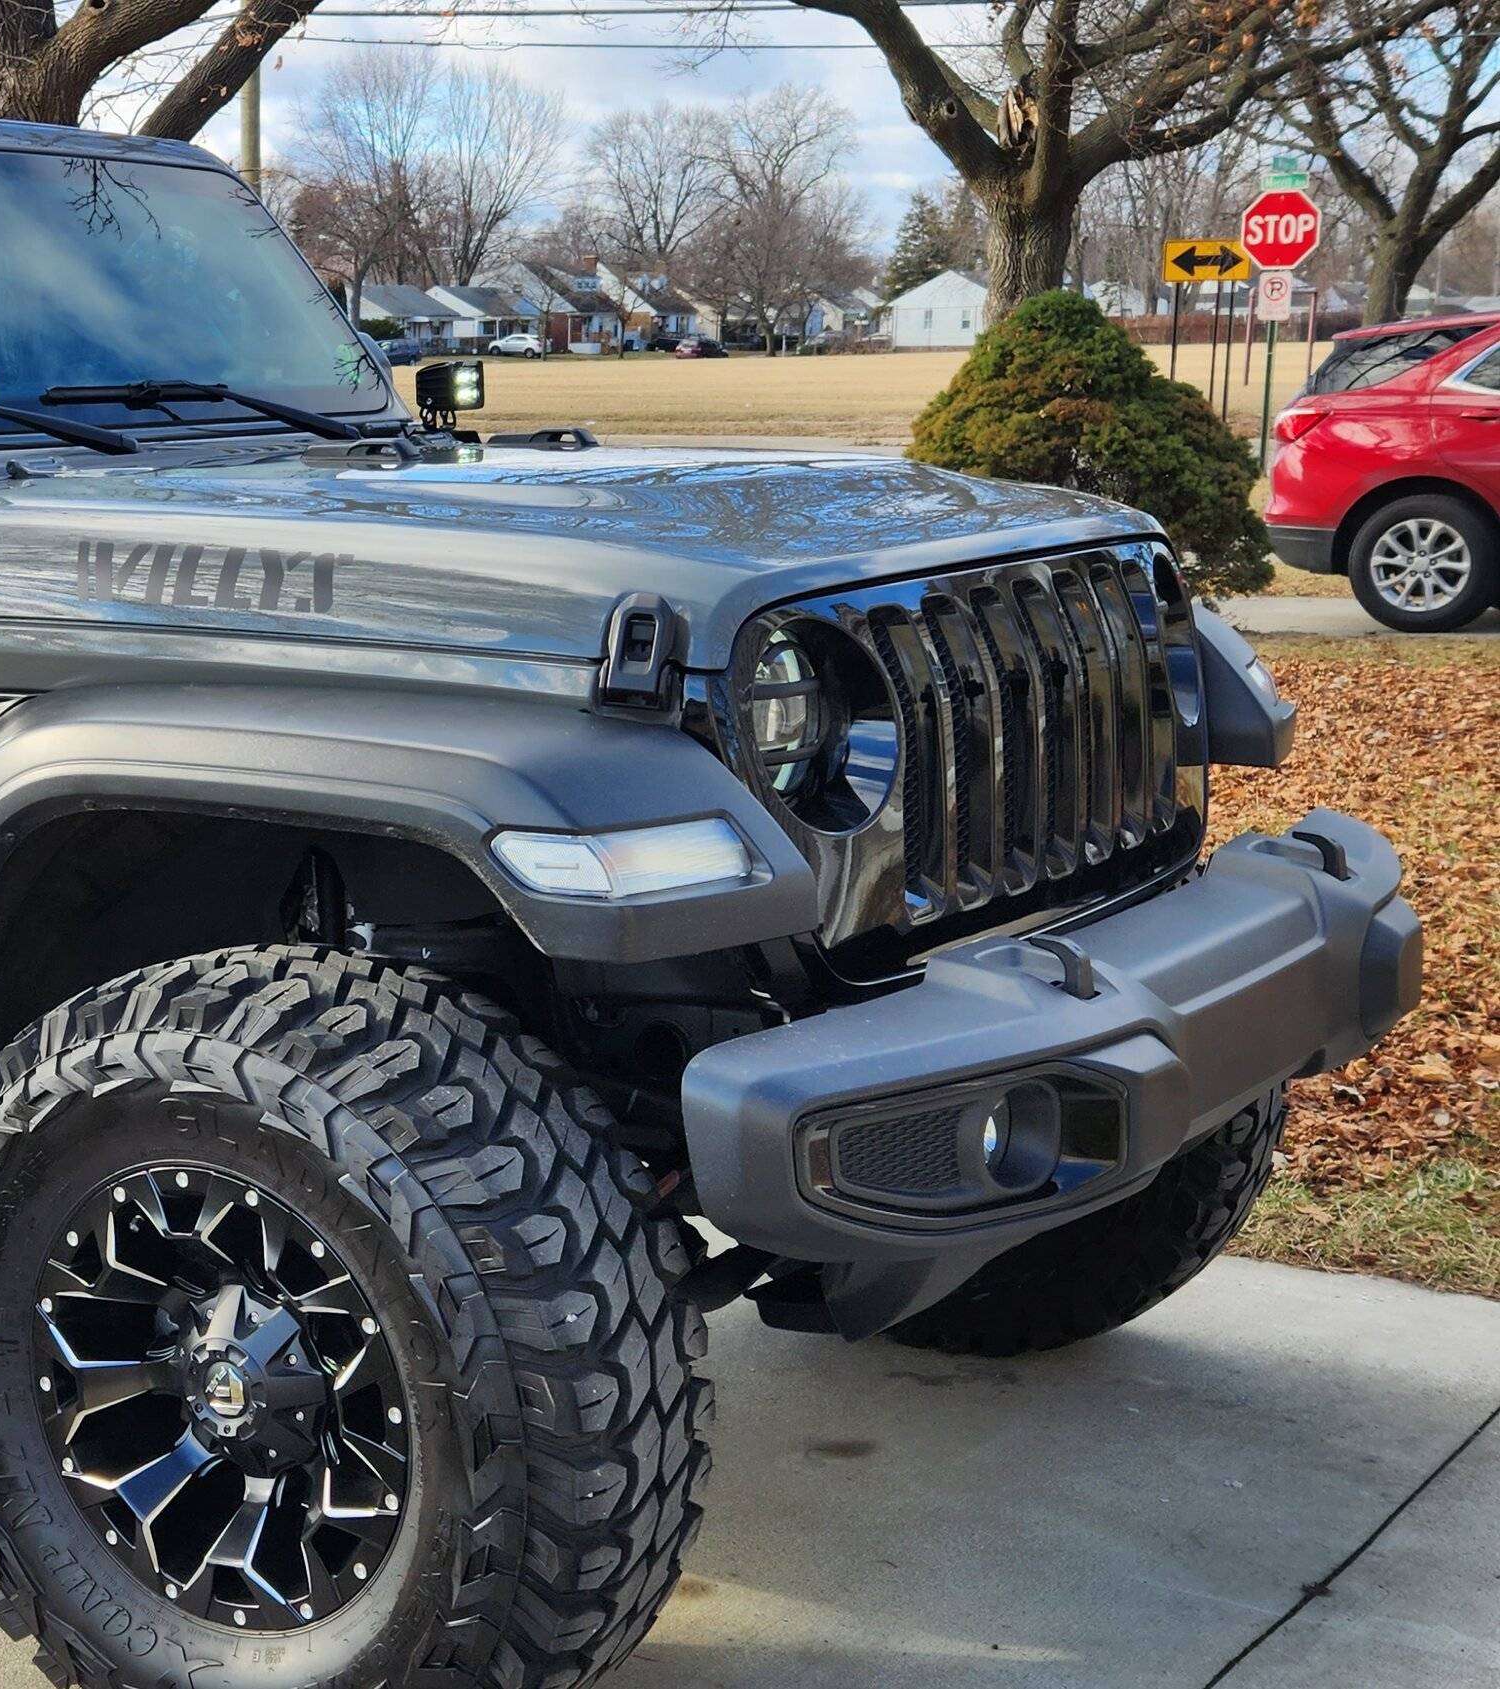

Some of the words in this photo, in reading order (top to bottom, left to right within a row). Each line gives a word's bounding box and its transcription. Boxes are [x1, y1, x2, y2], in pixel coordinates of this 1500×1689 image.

[1246, 213, 1315, 245] STOP
[77, 541, 354, 613] WILLYS
[205, 1366, 228, 1393] FUEL
